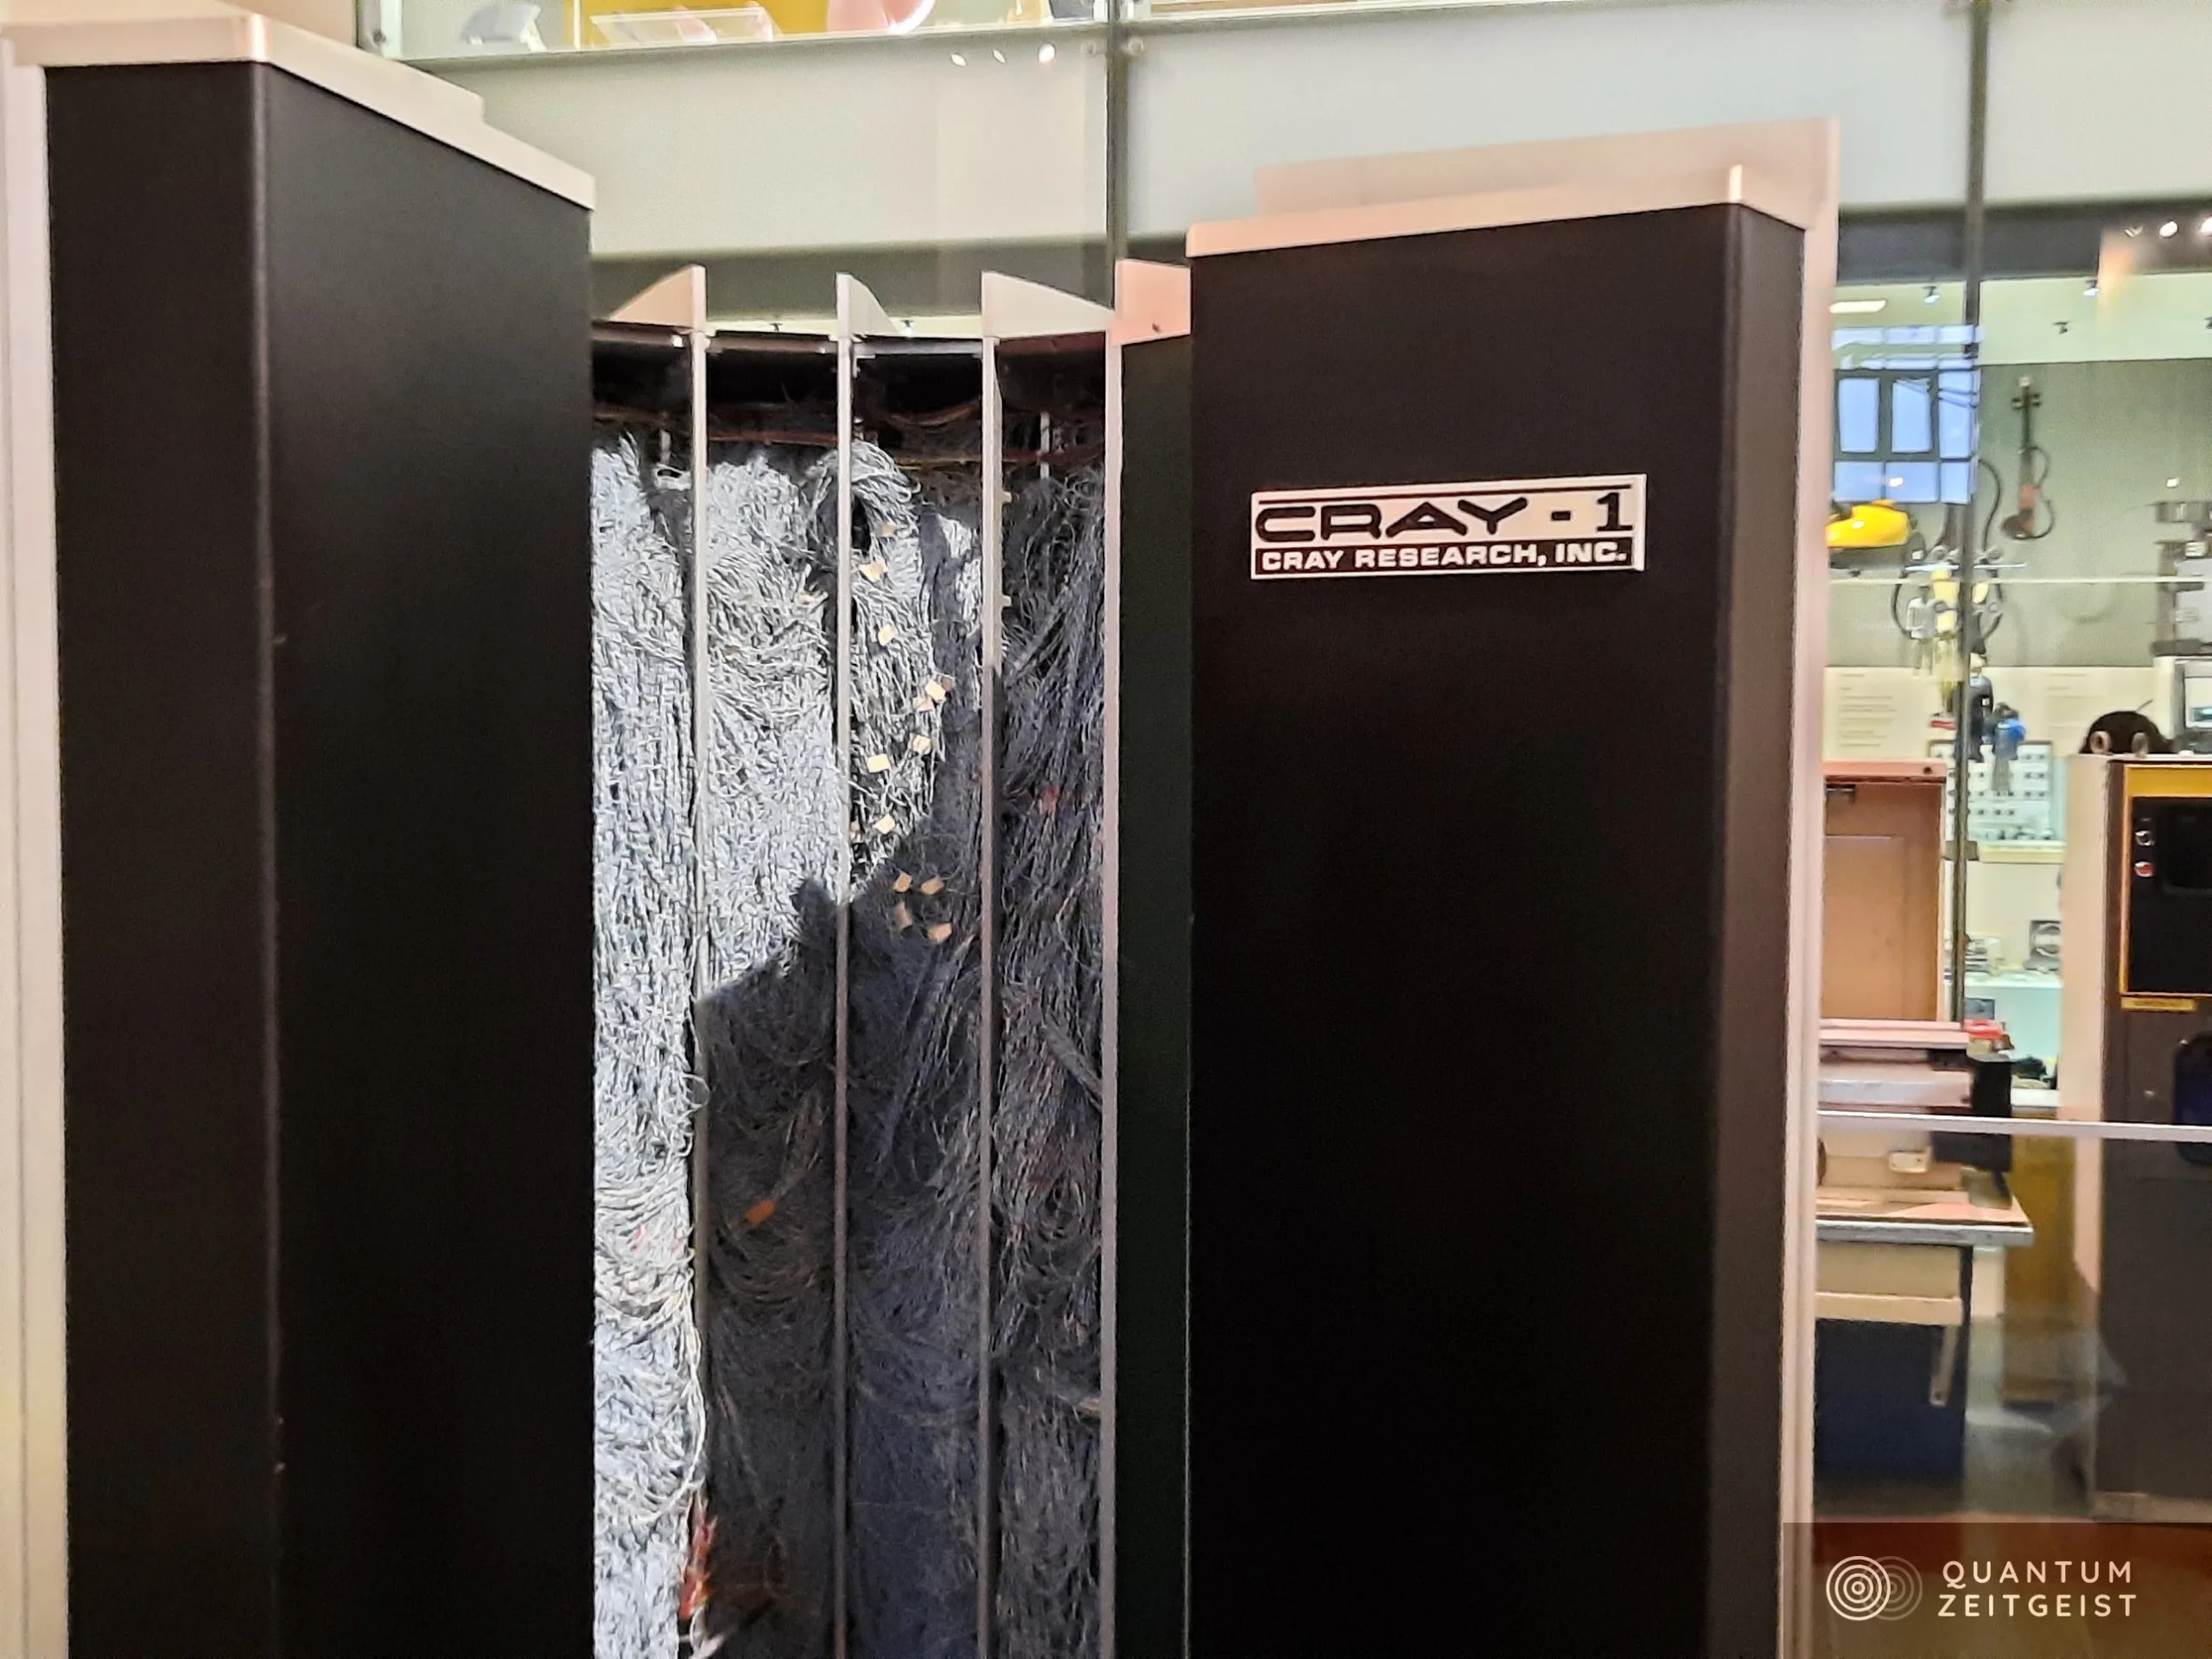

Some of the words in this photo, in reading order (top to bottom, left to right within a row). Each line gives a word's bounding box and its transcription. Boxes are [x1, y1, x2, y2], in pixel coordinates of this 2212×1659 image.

[1255, 498, 1528, 543] CRAY
[1596, 492, 1633, 533] 1
[1262, 549, 1344, 570] CRAY
[1354, 543, 1548, 568] RESEARCH,
[1554, 541, 1627, 563] INC.
